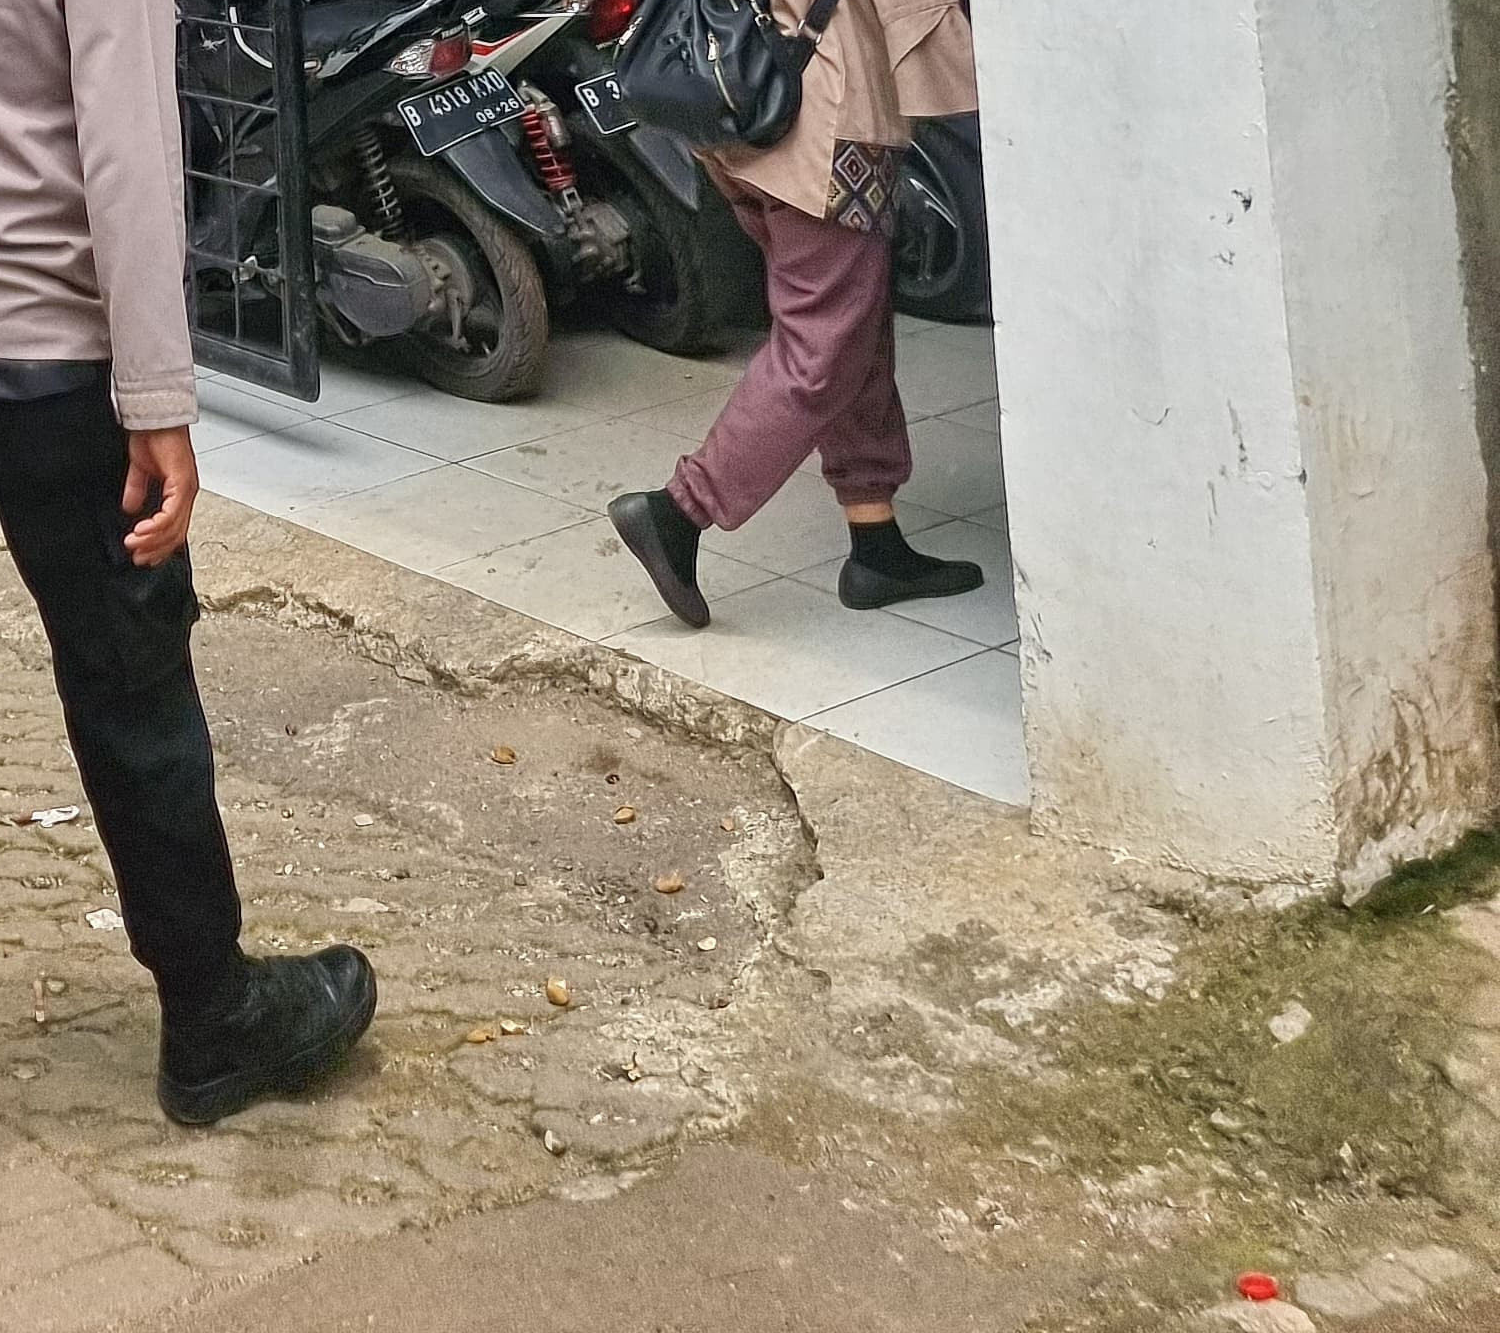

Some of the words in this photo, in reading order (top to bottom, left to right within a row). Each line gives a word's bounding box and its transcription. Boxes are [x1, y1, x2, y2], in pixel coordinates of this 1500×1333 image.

[403, 105, 422, 126] B
[428, 86, 471, 115] 4318
[467, 71, 505, 98] KXD
[582, 88, 600, 107] B
